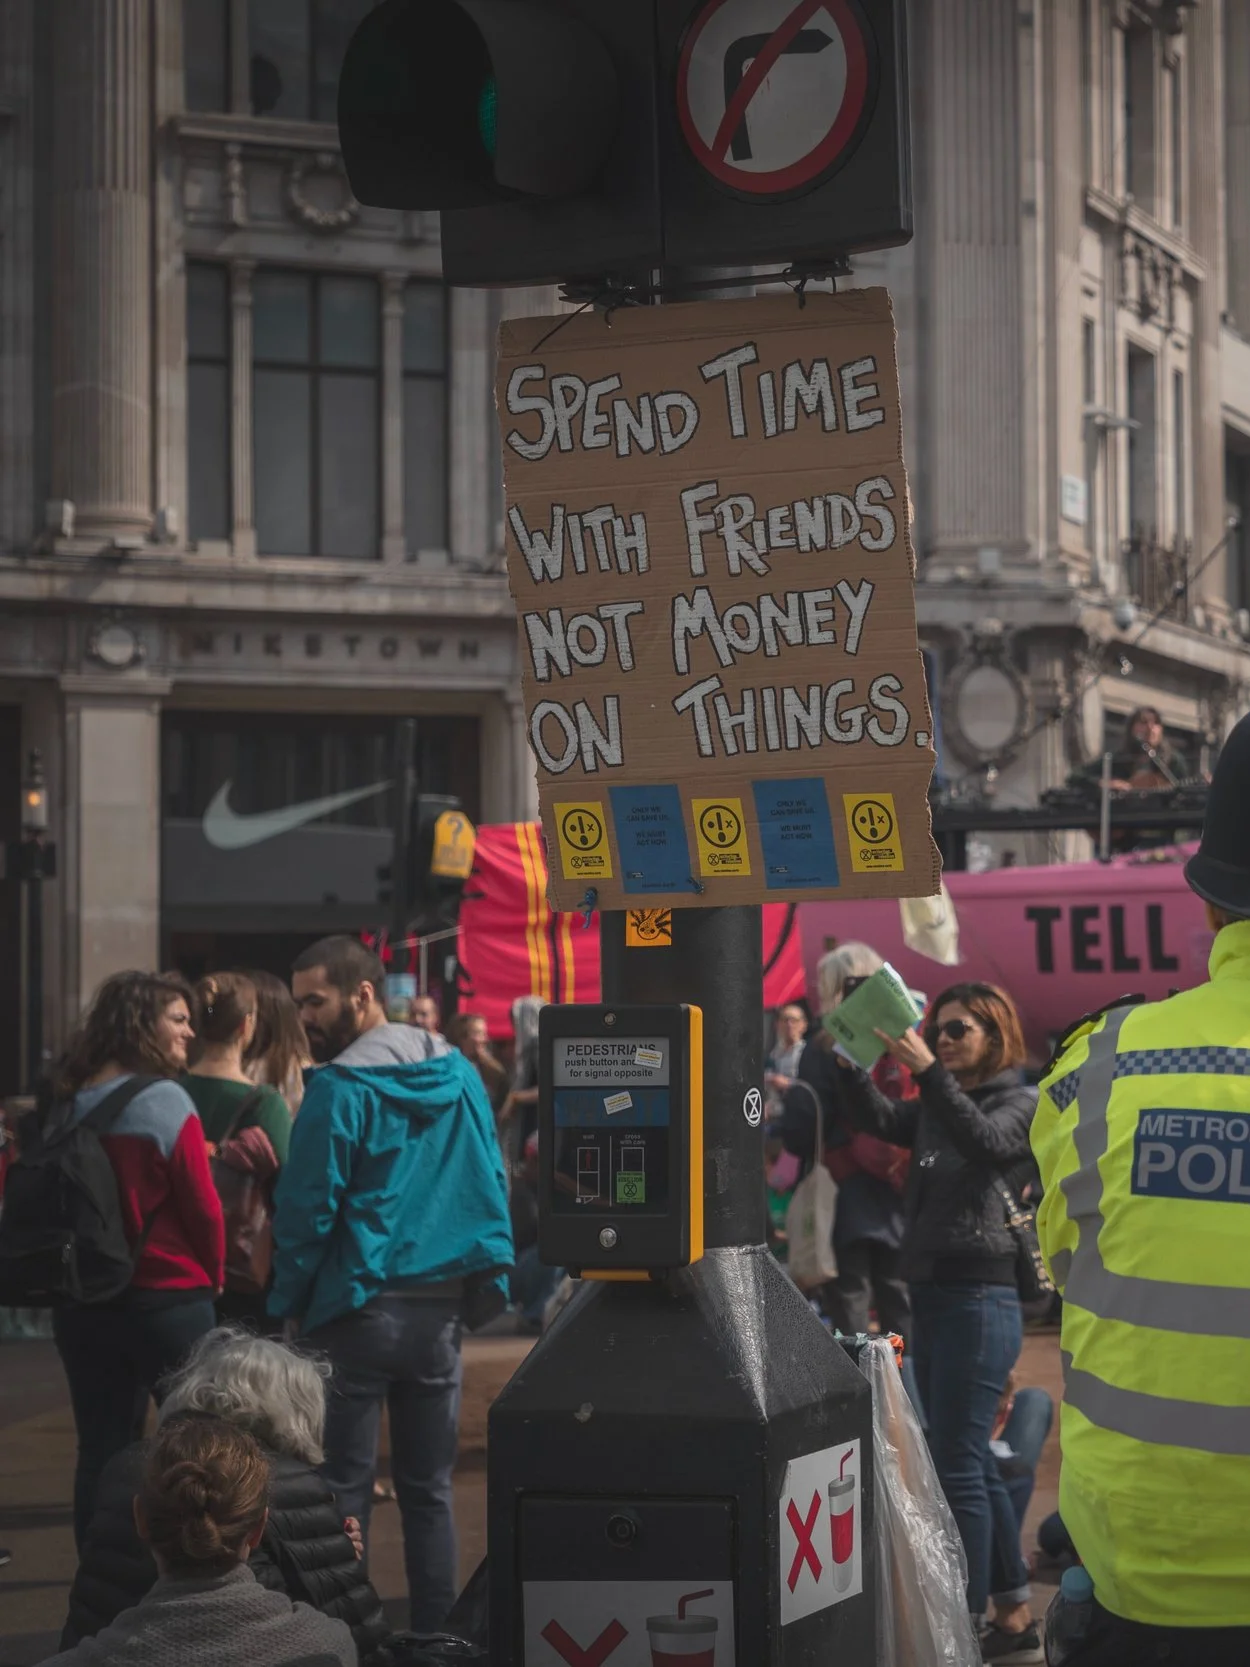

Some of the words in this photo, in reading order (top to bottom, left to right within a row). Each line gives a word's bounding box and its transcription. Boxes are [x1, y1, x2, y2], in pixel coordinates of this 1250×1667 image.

[506, 363, 699, 461] SPEND
[700, 341, 885, 439] TIME
[508, 503, 650, 584] WITH
[680, 475, 896, 578] FRIENDS
[193, 631, 480, 659] NIKETOWN
[524, 602, 644, 682] NOT
[672, 578, 875, 675] MONEY
[530, 695, 624, 775] ON
[673, 673, 929, 757] THINGS.
[1025, 903, 1179, 974] TELL
[565, 1058, 587, 1068] push
[589, 1058, 618, 1066] button
[570, 1069, 581, 1077] for
[585, 1069, 612, 1079] signal
[614, 1069, 653, 1079] opposite
